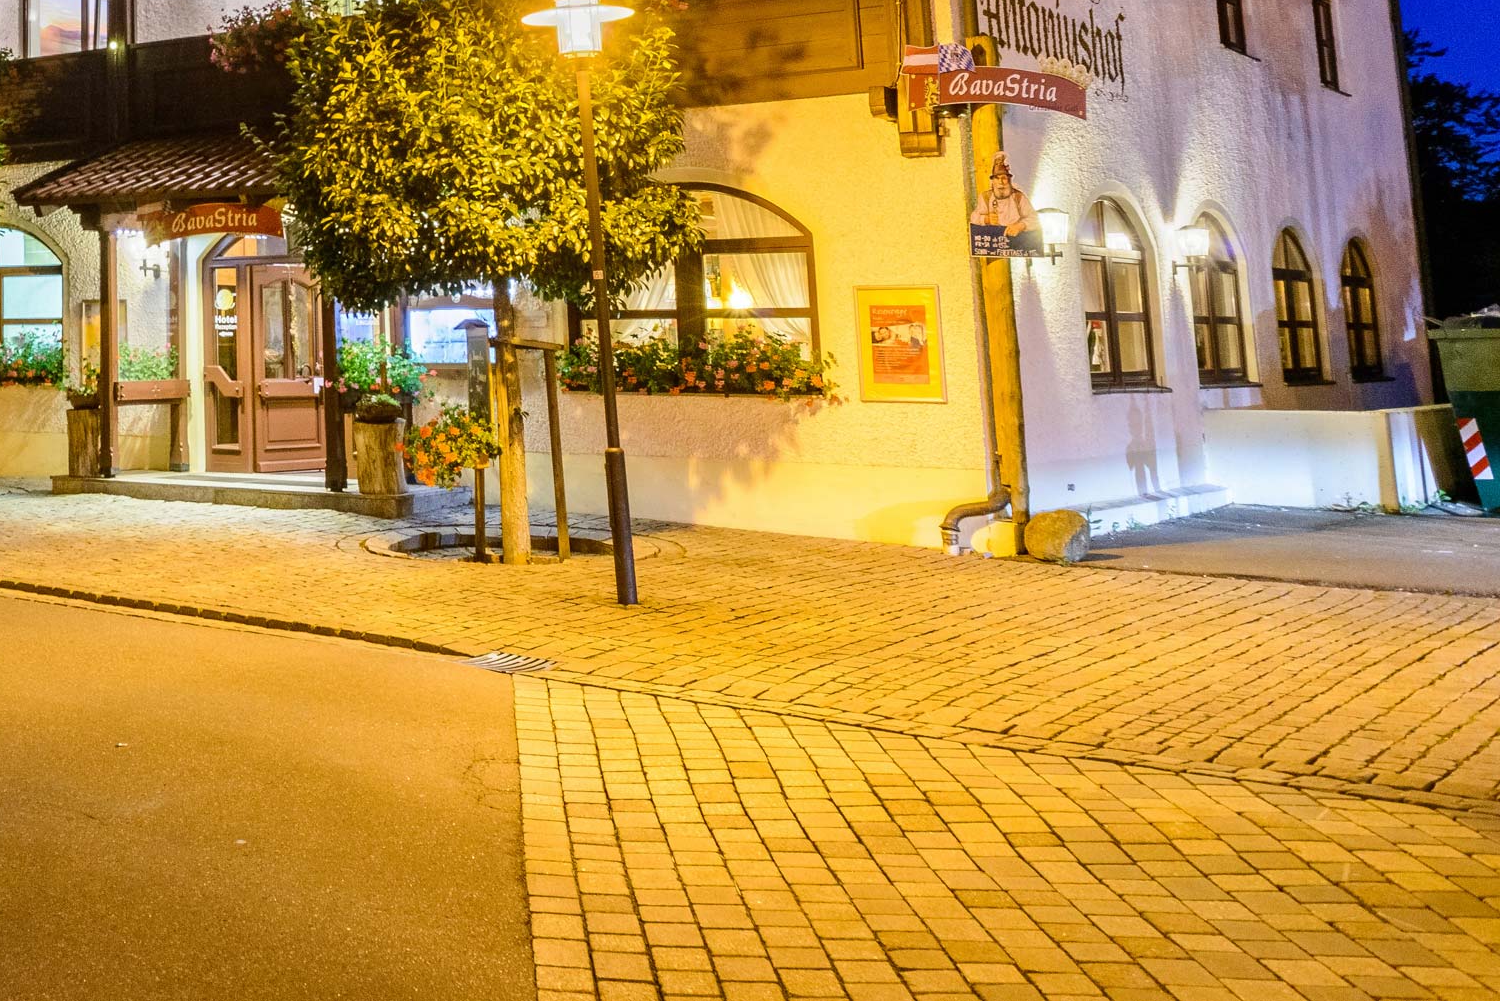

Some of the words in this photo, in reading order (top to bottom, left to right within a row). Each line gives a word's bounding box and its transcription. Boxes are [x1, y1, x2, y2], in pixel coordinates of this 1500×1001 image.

[949, 72, 1058, 102] BavaStria
[172, 208, 258, 232] BavaStria
[214, 314, 238, 324] Hotel
